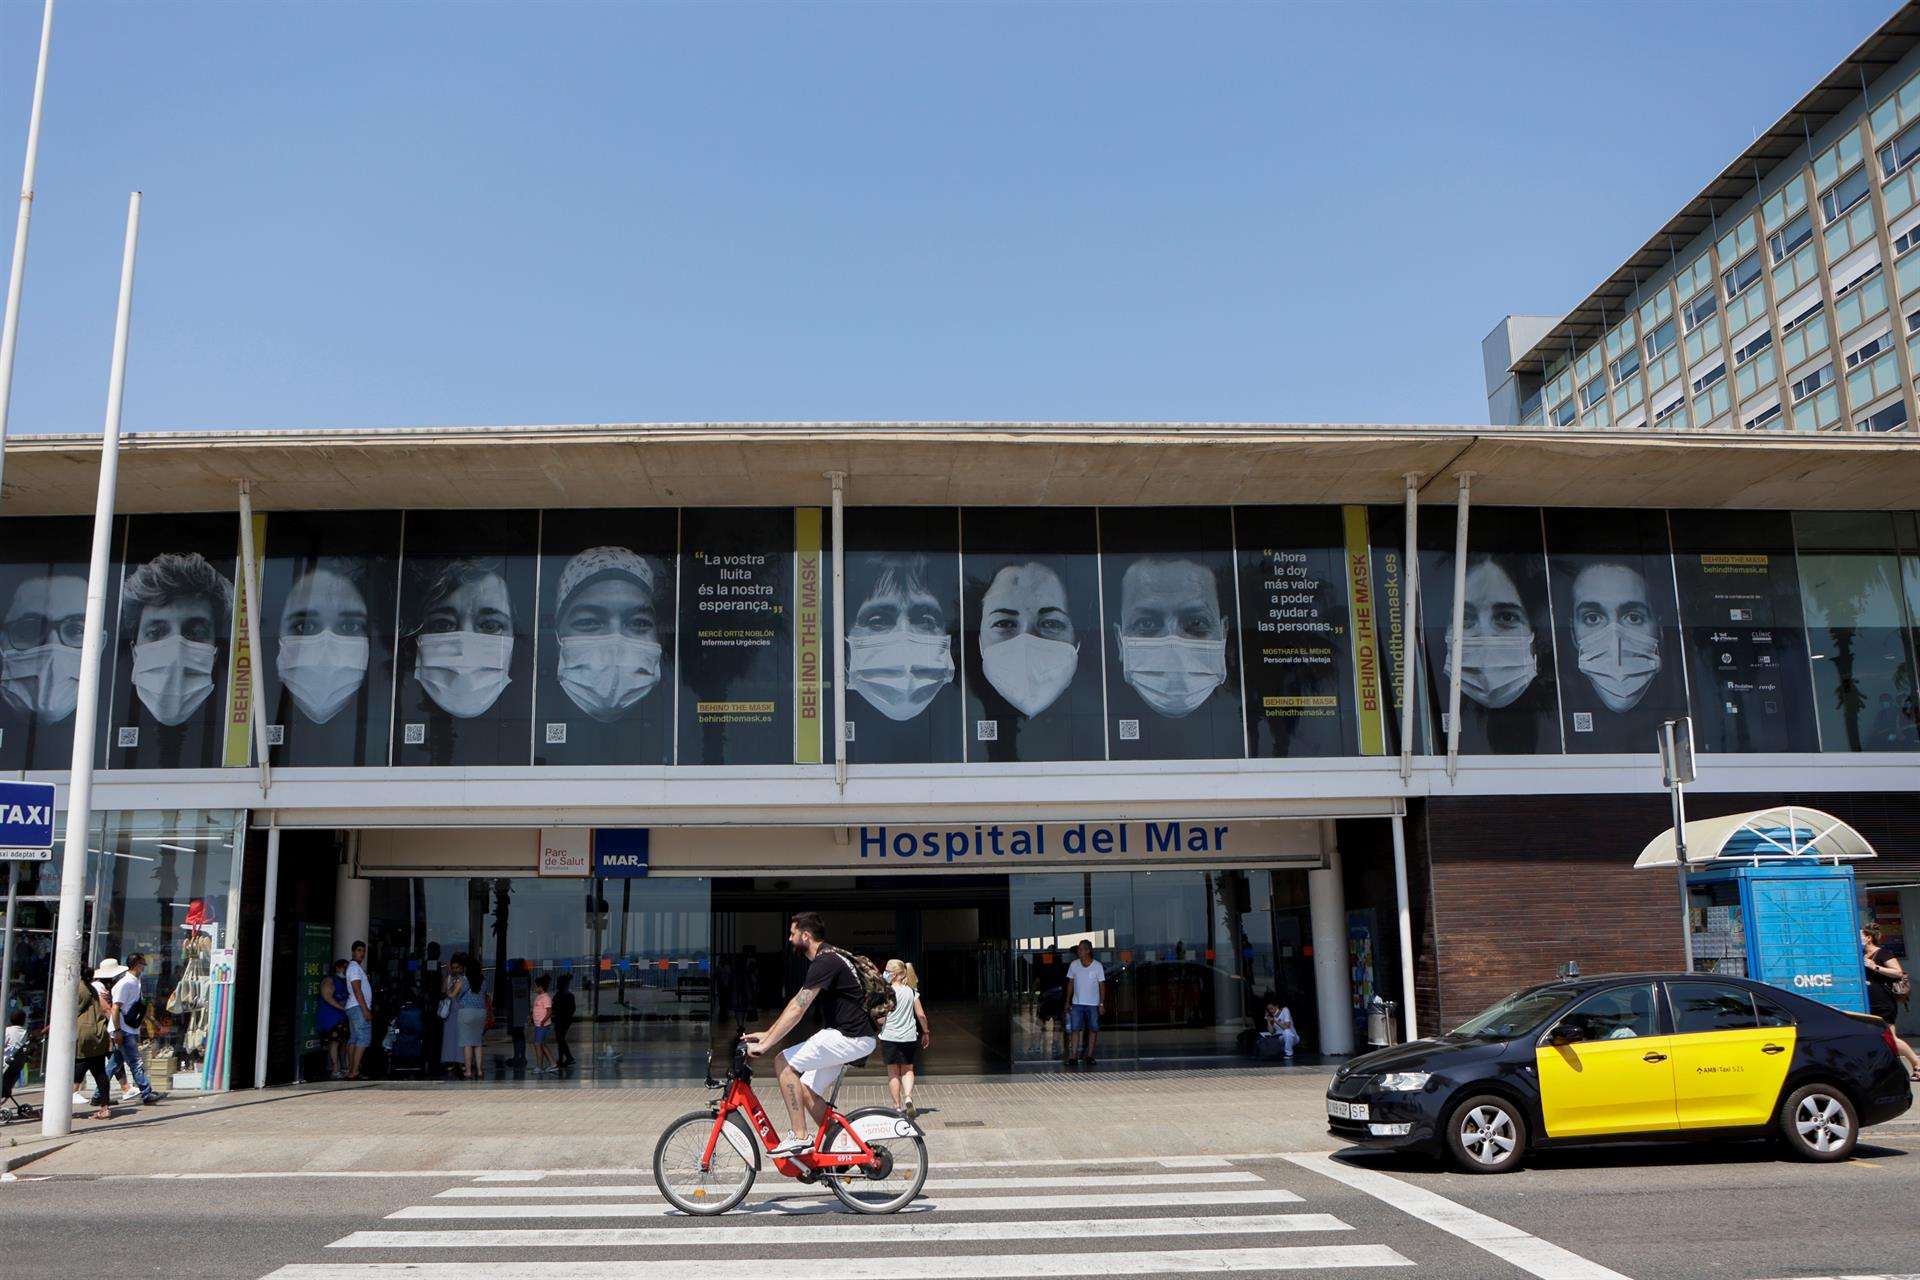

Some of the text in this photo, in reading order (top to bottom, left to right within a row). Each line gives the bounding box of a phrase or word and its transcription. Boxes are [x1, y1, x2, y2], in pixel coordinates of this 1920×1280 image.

[723, 554, 765, 565] vostra
[720, 568, 752, 580] lluita
[1274, 565, 1307, 578] le doy
[698, 583, 774, 595] és la nostra
[1265, 579, 1319, 590] más valor
[1271, 593, 1314, 605] a poder
[1270, 607, 1318, 620] ayudar a
[1258, 621, 1275, 632] las
[1353, 554, 1377, 711] BEHIND THE MASK
[723, 630, 744, 638] ORTIZ
[802, 557, 817, 719] BEHIND THE MASK
[701, 639, 734, 647] Informera
[1309, 657, 1331, 665] Neteja
[233, 657, 250, 723] BEHIND
[699, 714, 772, 723] behindthemask.es
[1265, 709, 1335, 718] behindthemask.es
[860, 821, 1227, 862] Hospital del Mar
[545, 848, 567, 857] Parc
[545, 857, 584, 866] de Salut
[1793, 974, 1833, 987] ONCE
[1352, 1106, 1365, 1118] SP
